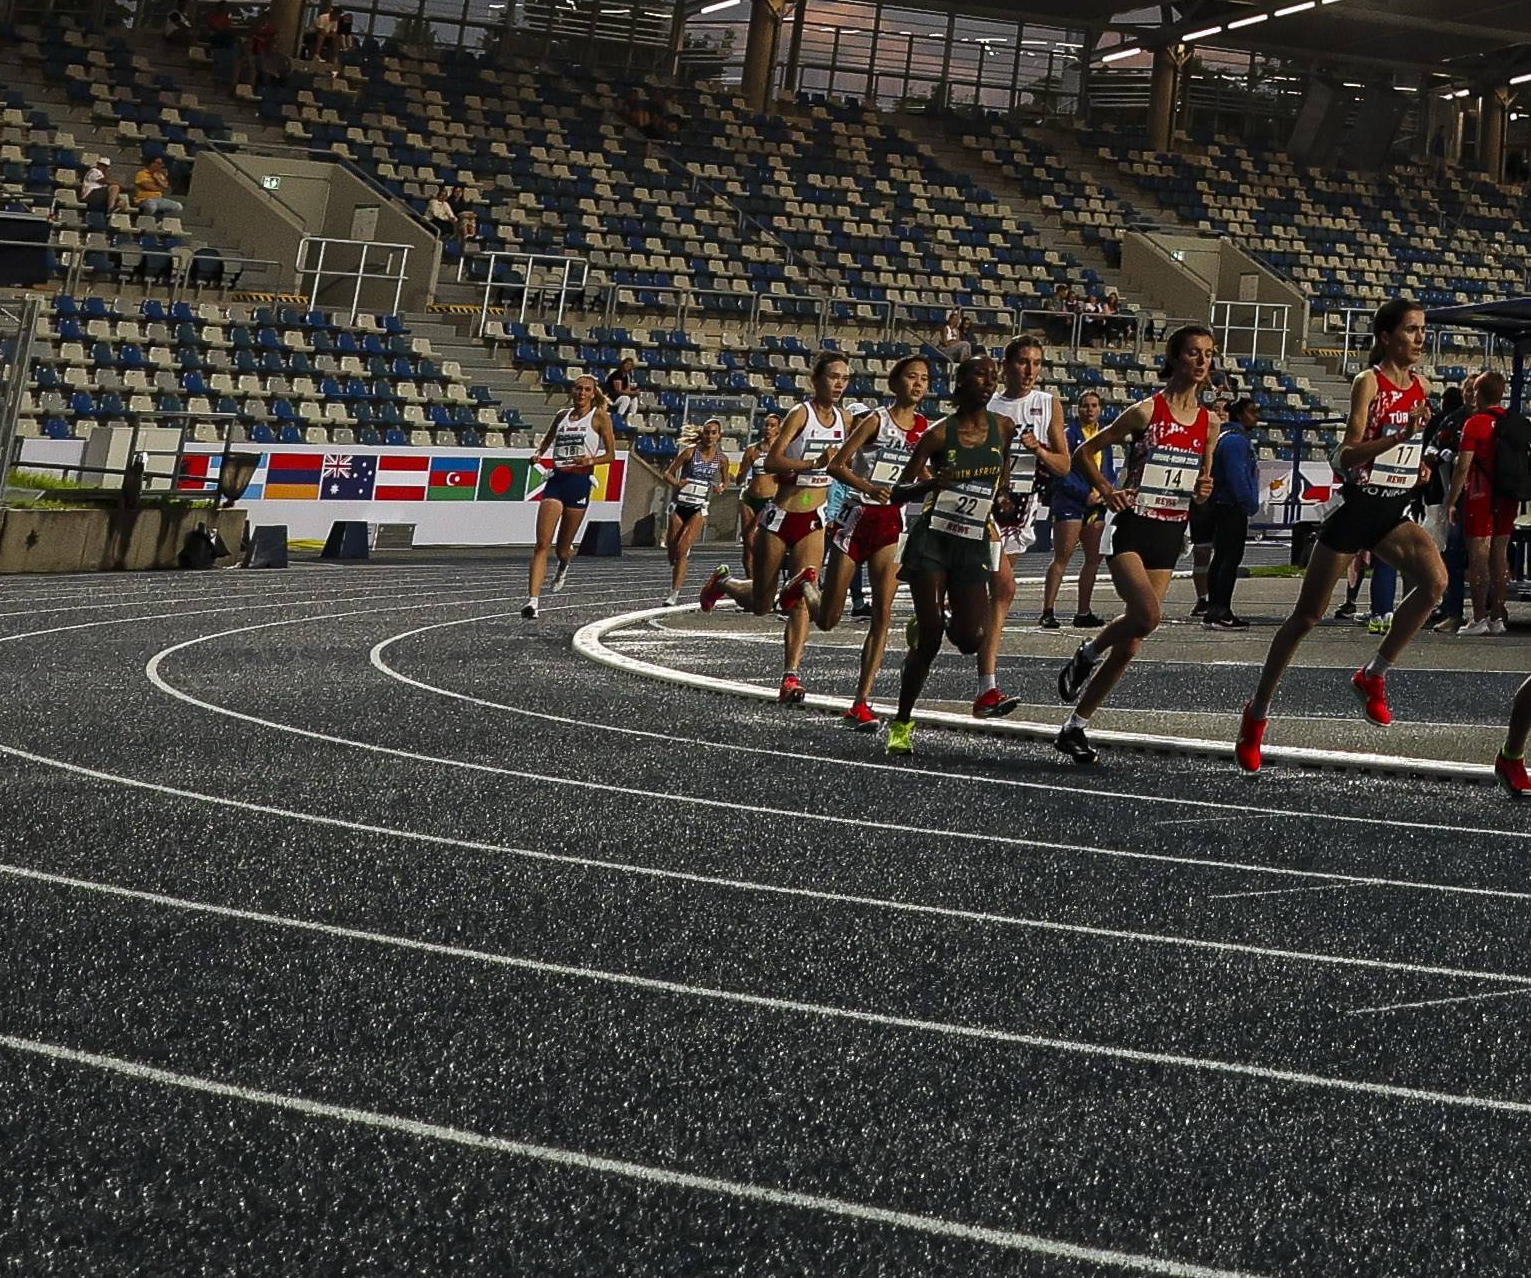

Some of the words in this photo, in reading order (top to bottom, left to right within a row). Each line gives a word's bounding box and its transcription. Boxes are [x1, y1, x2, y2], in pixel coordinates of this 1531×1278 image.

[1397, 446, 1414, 465] 17
[888, 466, 901, 482] 2
[1164, 469, 1183, 488] 14
[955, 496, 978, 516] 22
